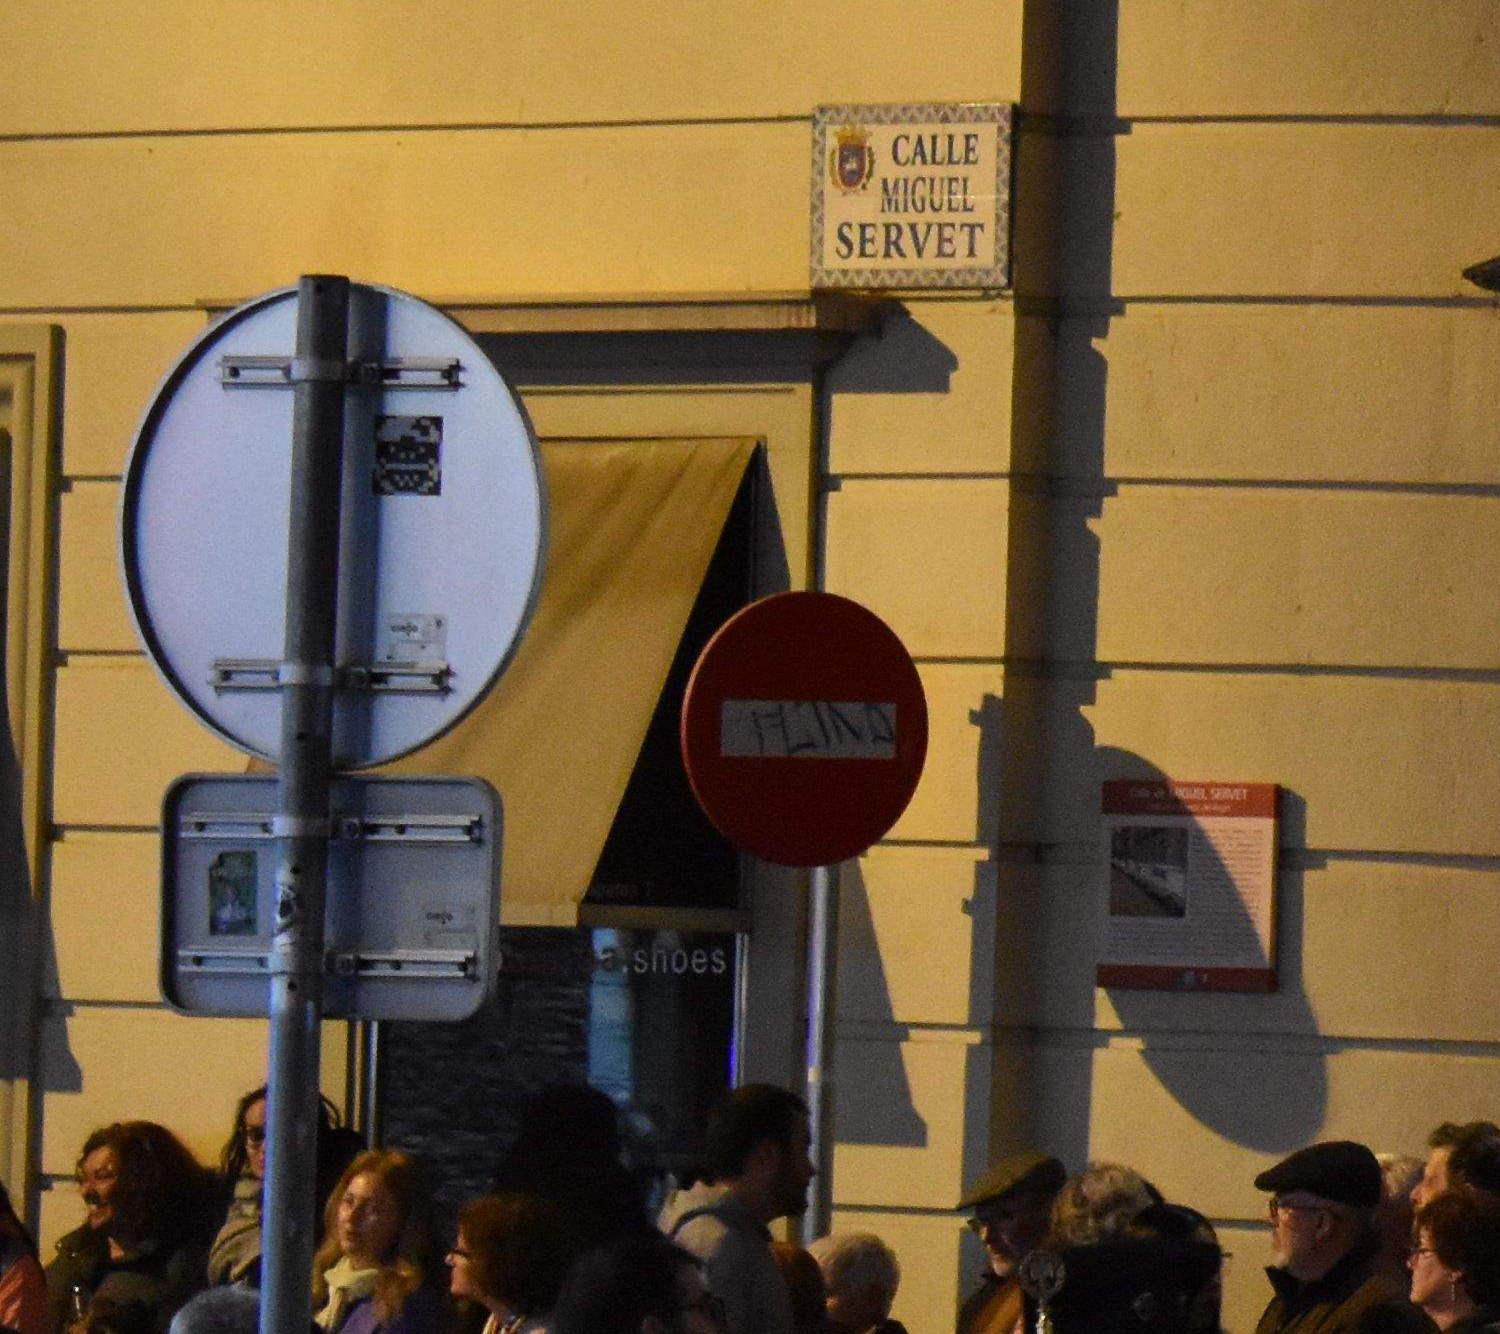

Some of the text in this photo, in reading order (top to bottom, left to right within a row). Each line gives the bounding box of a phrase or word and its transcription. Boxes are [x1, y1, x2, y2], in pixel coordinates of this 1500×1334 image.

[891, 133, 980, 167] CALLE
[880, 176, 975, 214] MIGUEL
[835, 221, 985, 260] SERVET
